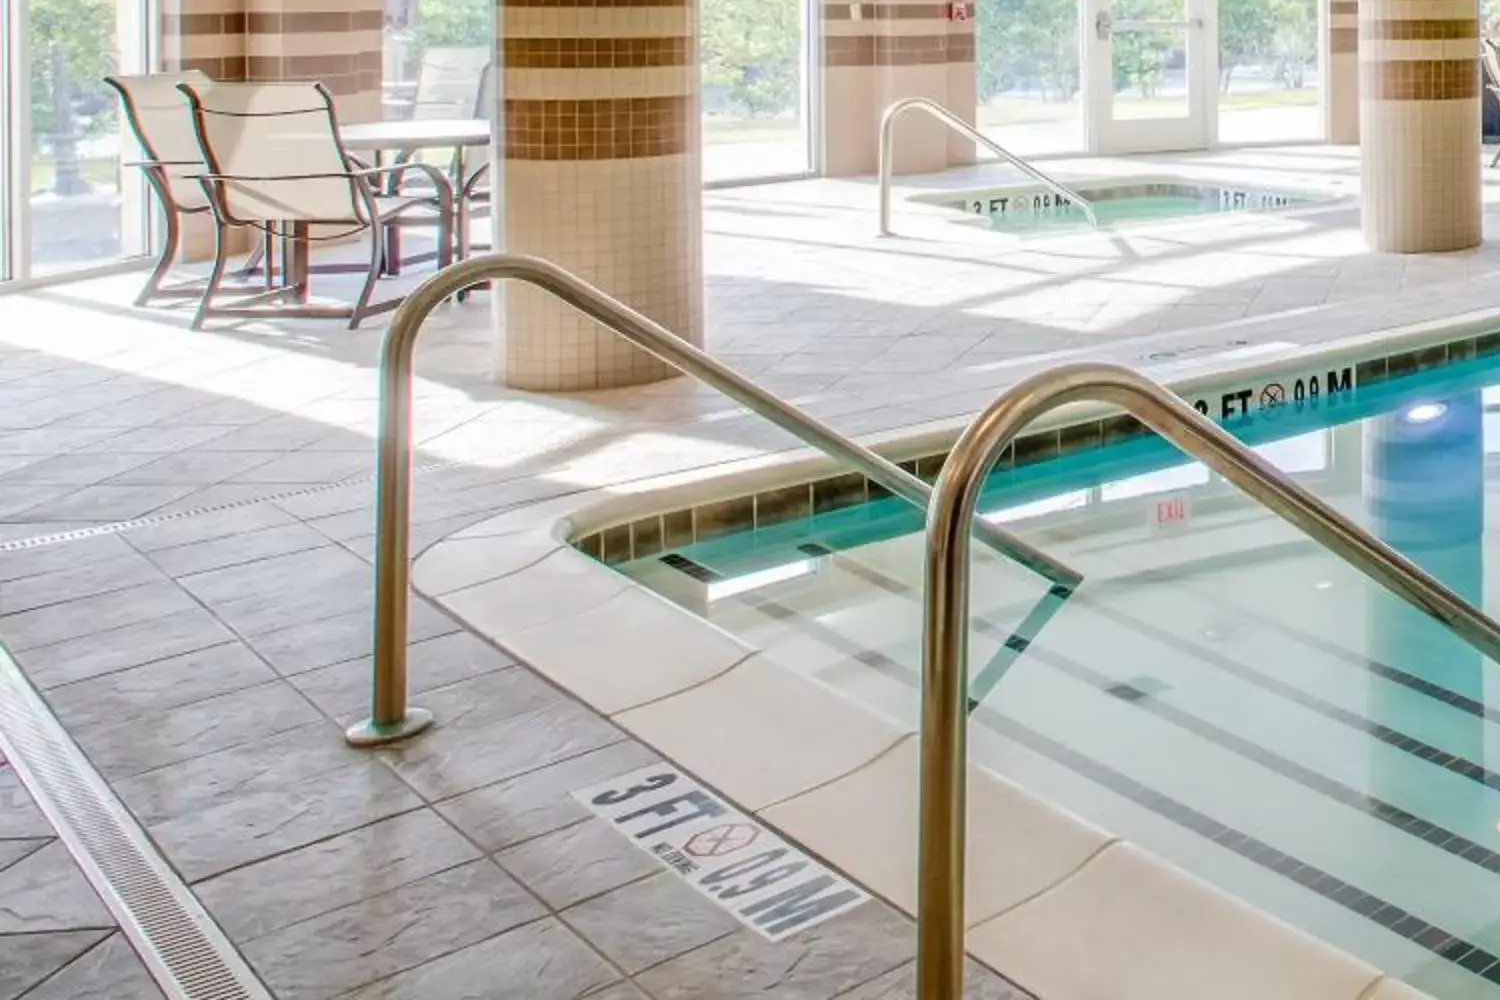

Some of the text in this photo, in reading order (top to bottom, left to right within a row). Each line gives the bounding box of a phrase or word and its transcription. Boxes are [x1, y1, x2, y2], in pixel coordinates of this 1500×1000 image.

[1222, 389, 1253, 418] FT
[1327, 367, 1352, 394] M
[592, 773, 862, 934] 3 FT 0.9 M
